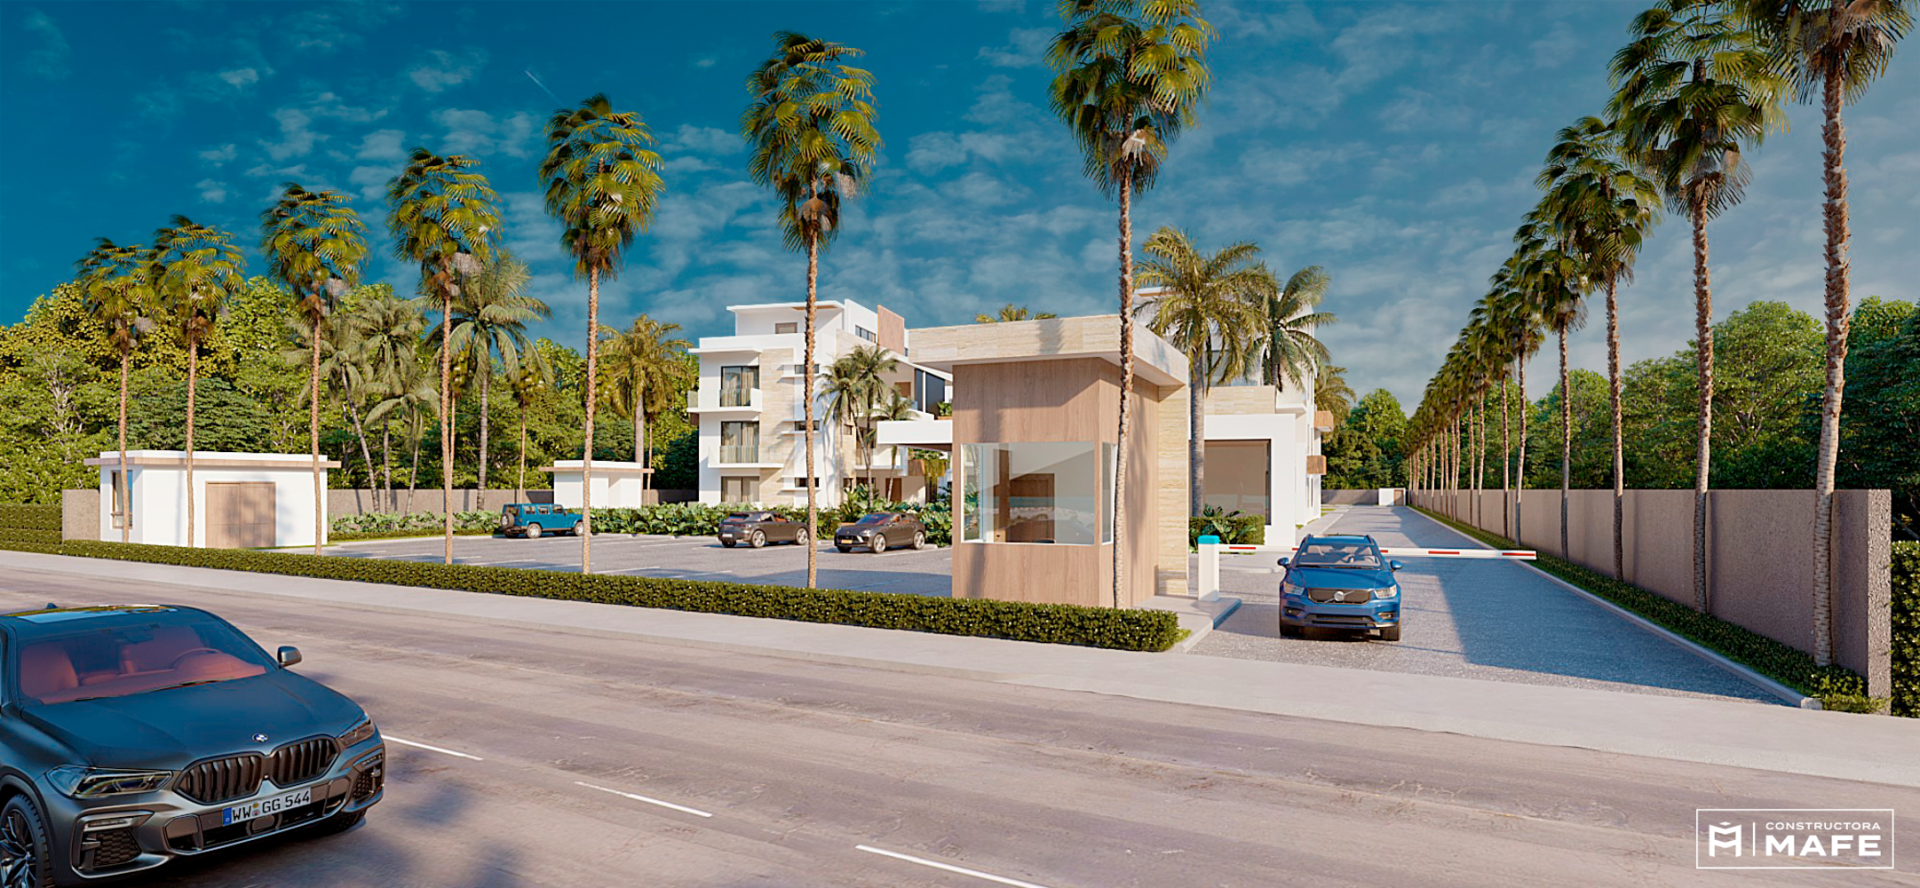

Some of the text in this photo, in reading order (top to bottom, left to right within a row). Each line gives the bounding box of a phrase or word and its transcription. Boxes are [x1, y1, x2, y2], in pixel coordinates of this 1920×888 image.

[232, 807, 251, 821] WW
[262, 800, 280, 813] GG
[285, 791, 310, 807] 544
